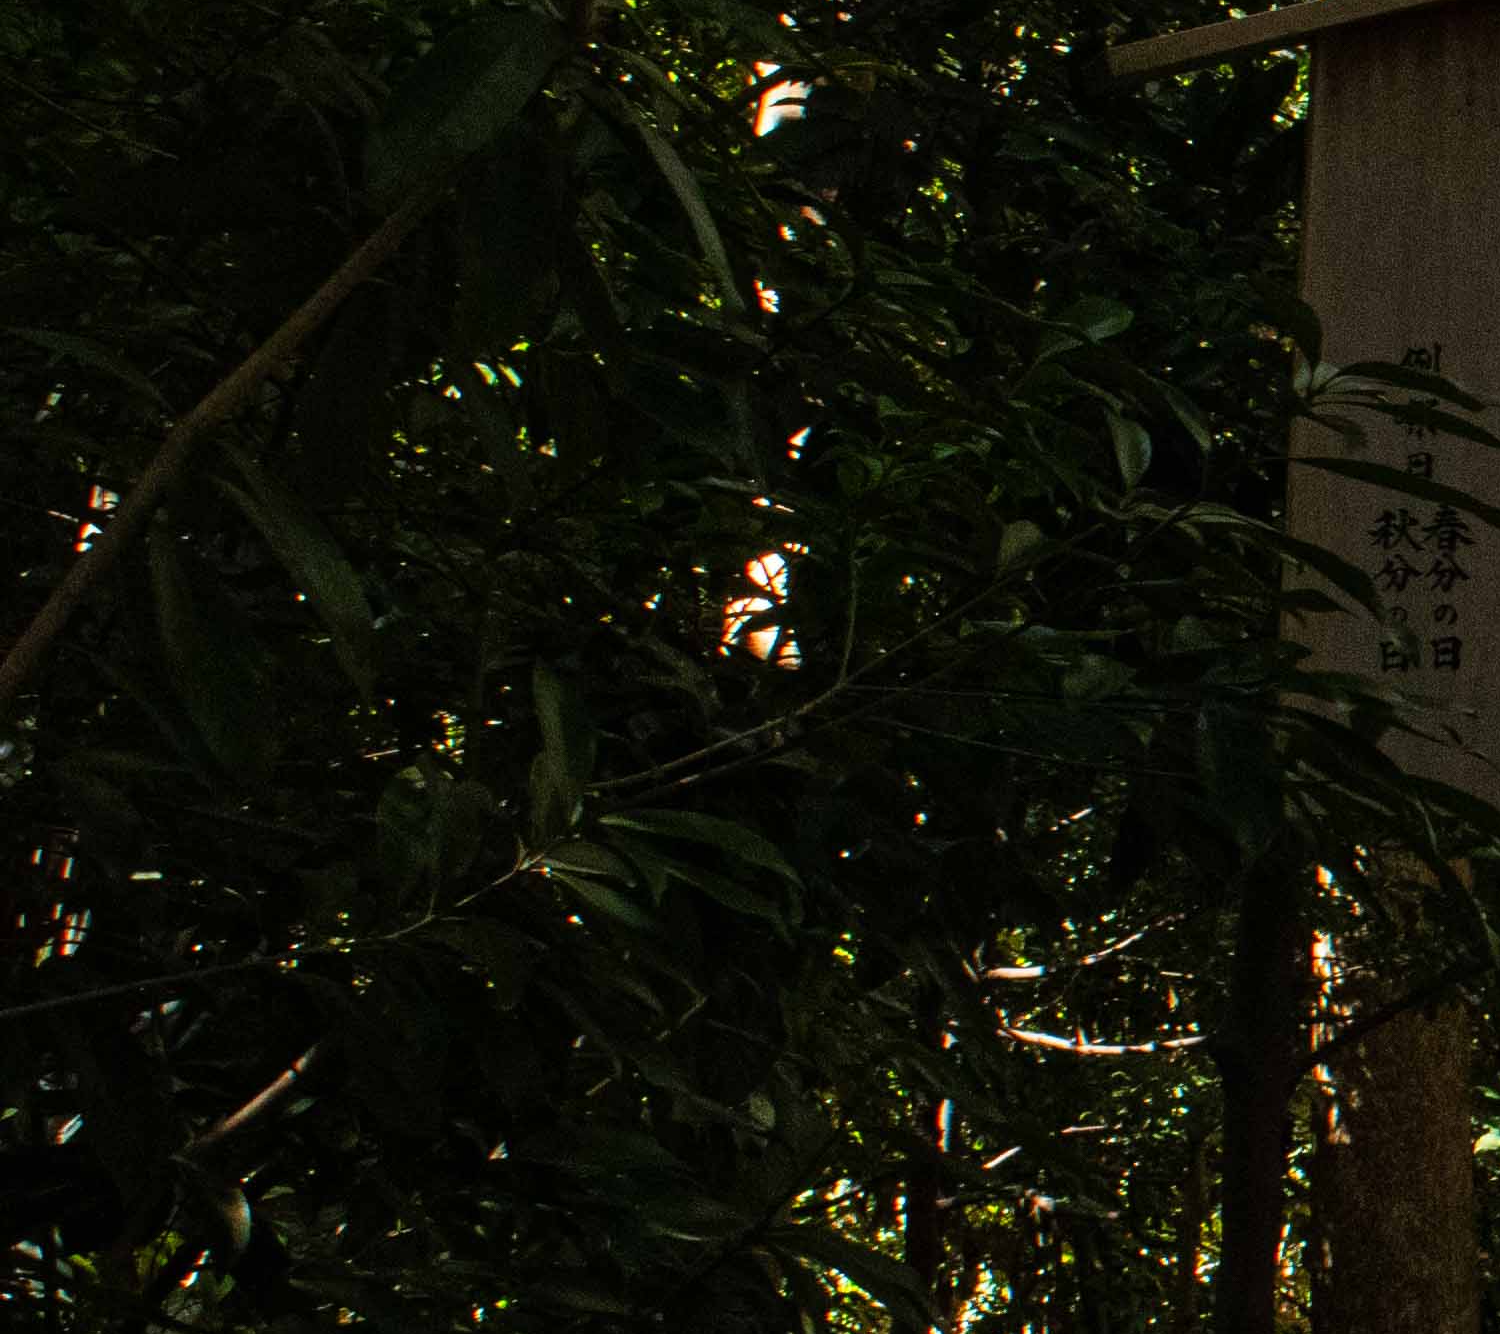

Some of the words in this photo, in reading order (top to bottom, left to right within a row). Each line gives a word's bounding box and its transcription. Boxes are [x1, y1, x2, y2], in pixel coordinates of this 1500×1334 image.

[1397, 341, 1442, 480] 例日
[1420, 501, 1475, 672] 春分の日
